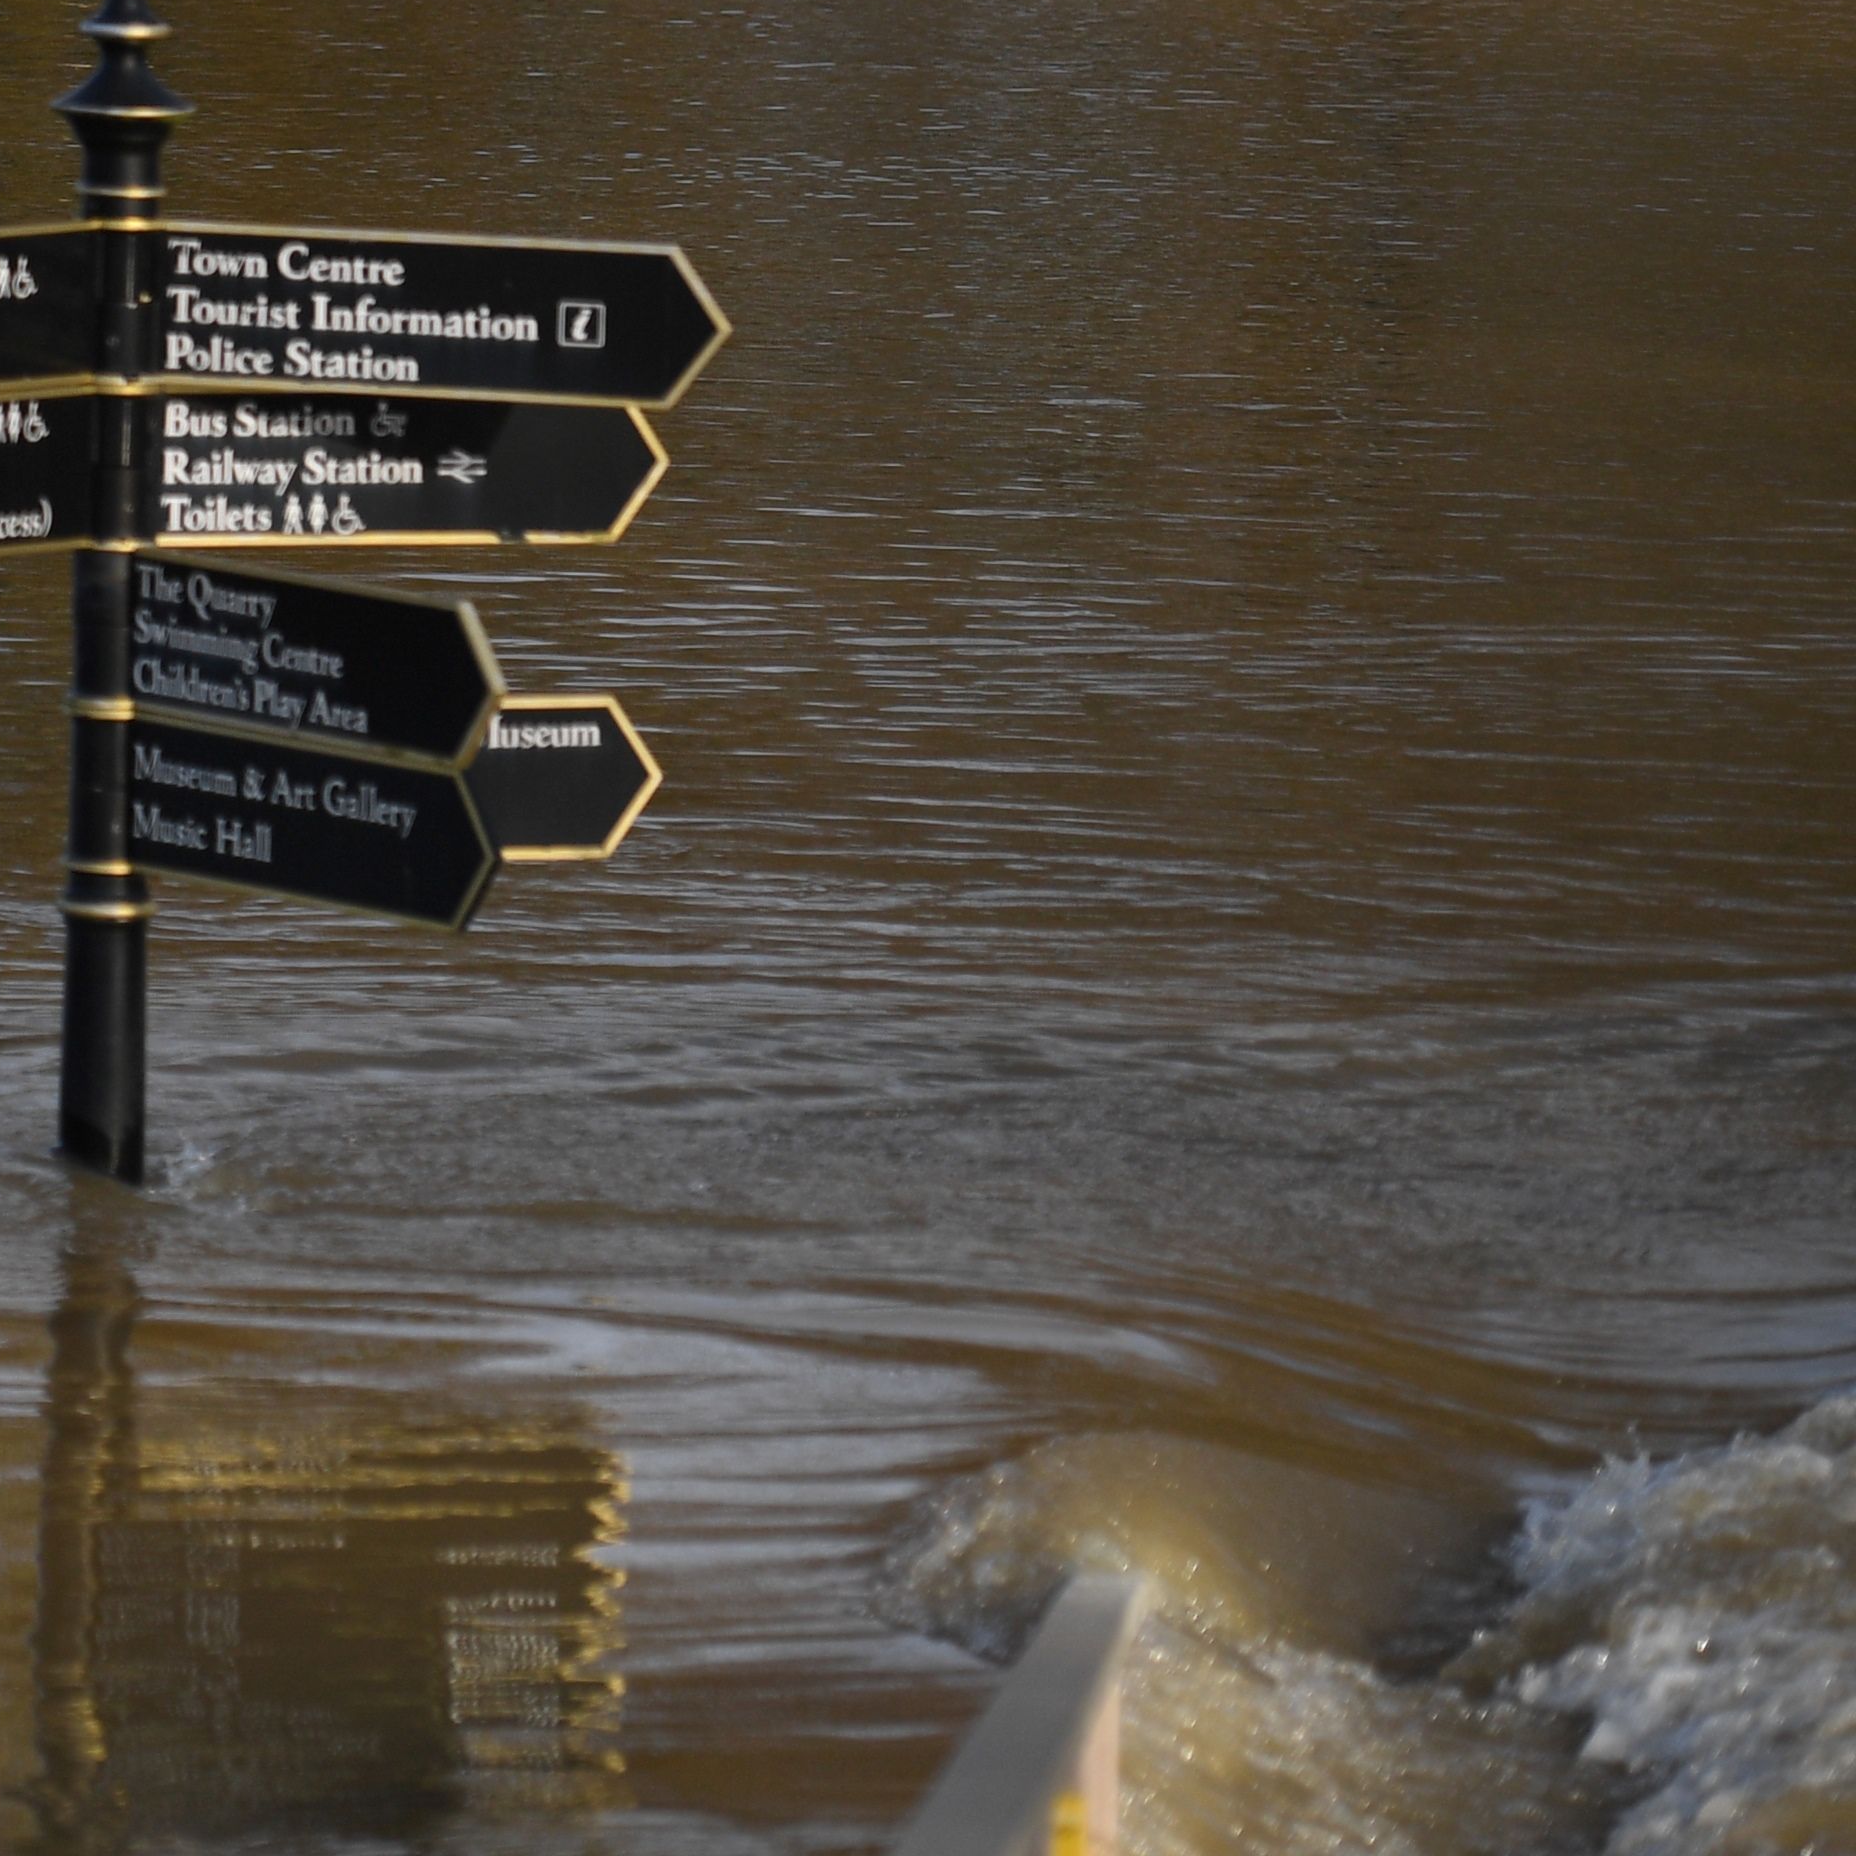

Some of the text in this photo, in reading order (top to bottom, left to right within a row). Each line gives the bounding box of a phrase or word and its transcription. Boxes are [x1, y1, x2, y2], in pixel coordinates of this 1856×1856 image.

[168, 237, 405, 286] Town Centre
[166, 287, 301, 329] Tourist
[311, 293, 539, 342] Information
[165, 332, 419, 382] Police Station
[164, 399, 356, 438] Bus Station
[162, 446, 423, 496] Railway Station
[161, 492, 272, 532] Toilets
[138, 564, 277, 629] The Quarry
[134, 608, 344, 678] Swimming Centre
[133, 658, 368, 734] Children's Play Area
[133, 744, 417, 839] Museum & Art Gallery
[132, 803, 273, 863] Music Hall
